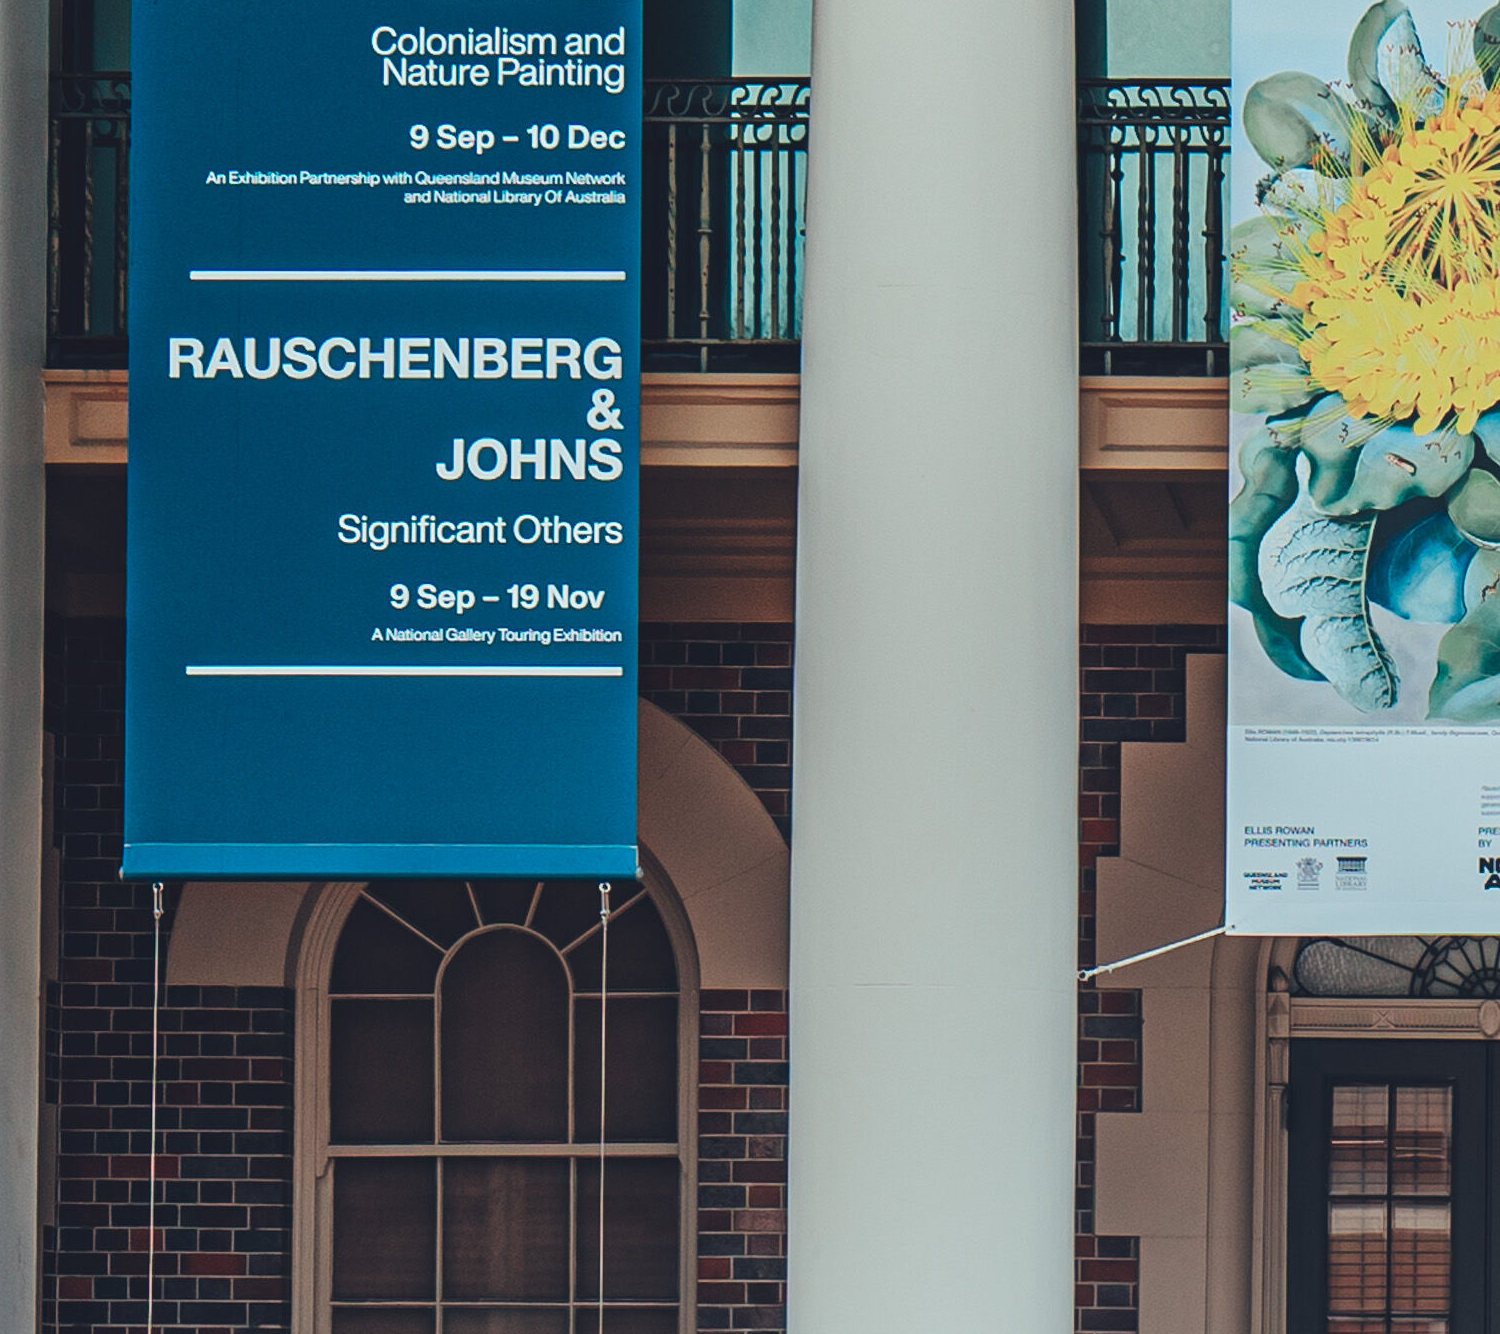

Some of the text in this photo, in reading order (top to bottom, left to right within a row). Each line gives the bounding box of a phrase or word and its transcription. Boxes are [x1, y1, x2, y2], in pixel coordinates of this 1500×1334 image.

[372, 26, 624, 55] Colonialism and
[383, 57, 624, 93] Nature Painting
[410, 125, 429, 149] 9
[437, 124, 494, 154] Sep
[527, 124, 559, 149] 10
[569, 125, 625, 149] Dec
[206, 171, 626, 187] An Exhibition Partnership with Queensland Museum Network
[404, 190, 625, 206] and National Library Of Australia
[169, 337, 622, 379] RAUSCHENBERG
[587, 389, 624, 430] &
[436, 438, 623, 480] JOHNS
[338, 514, 622, 550] Significant Others
[391, 584, 409, 608] 9
[417, 584, 475, 614] Sep
[507, 584, 539, 609] 19
[548, 585, 605, 609] Nov
[372, 628, 622, 644] A National Gallery Touring Exhibition
[1244, 826, 1315, 835] ELLIS ROWAN
[1244, 838, 1368, 847] PRESENTING PARTNERS
[1478, 840, 1492, 848] BY
